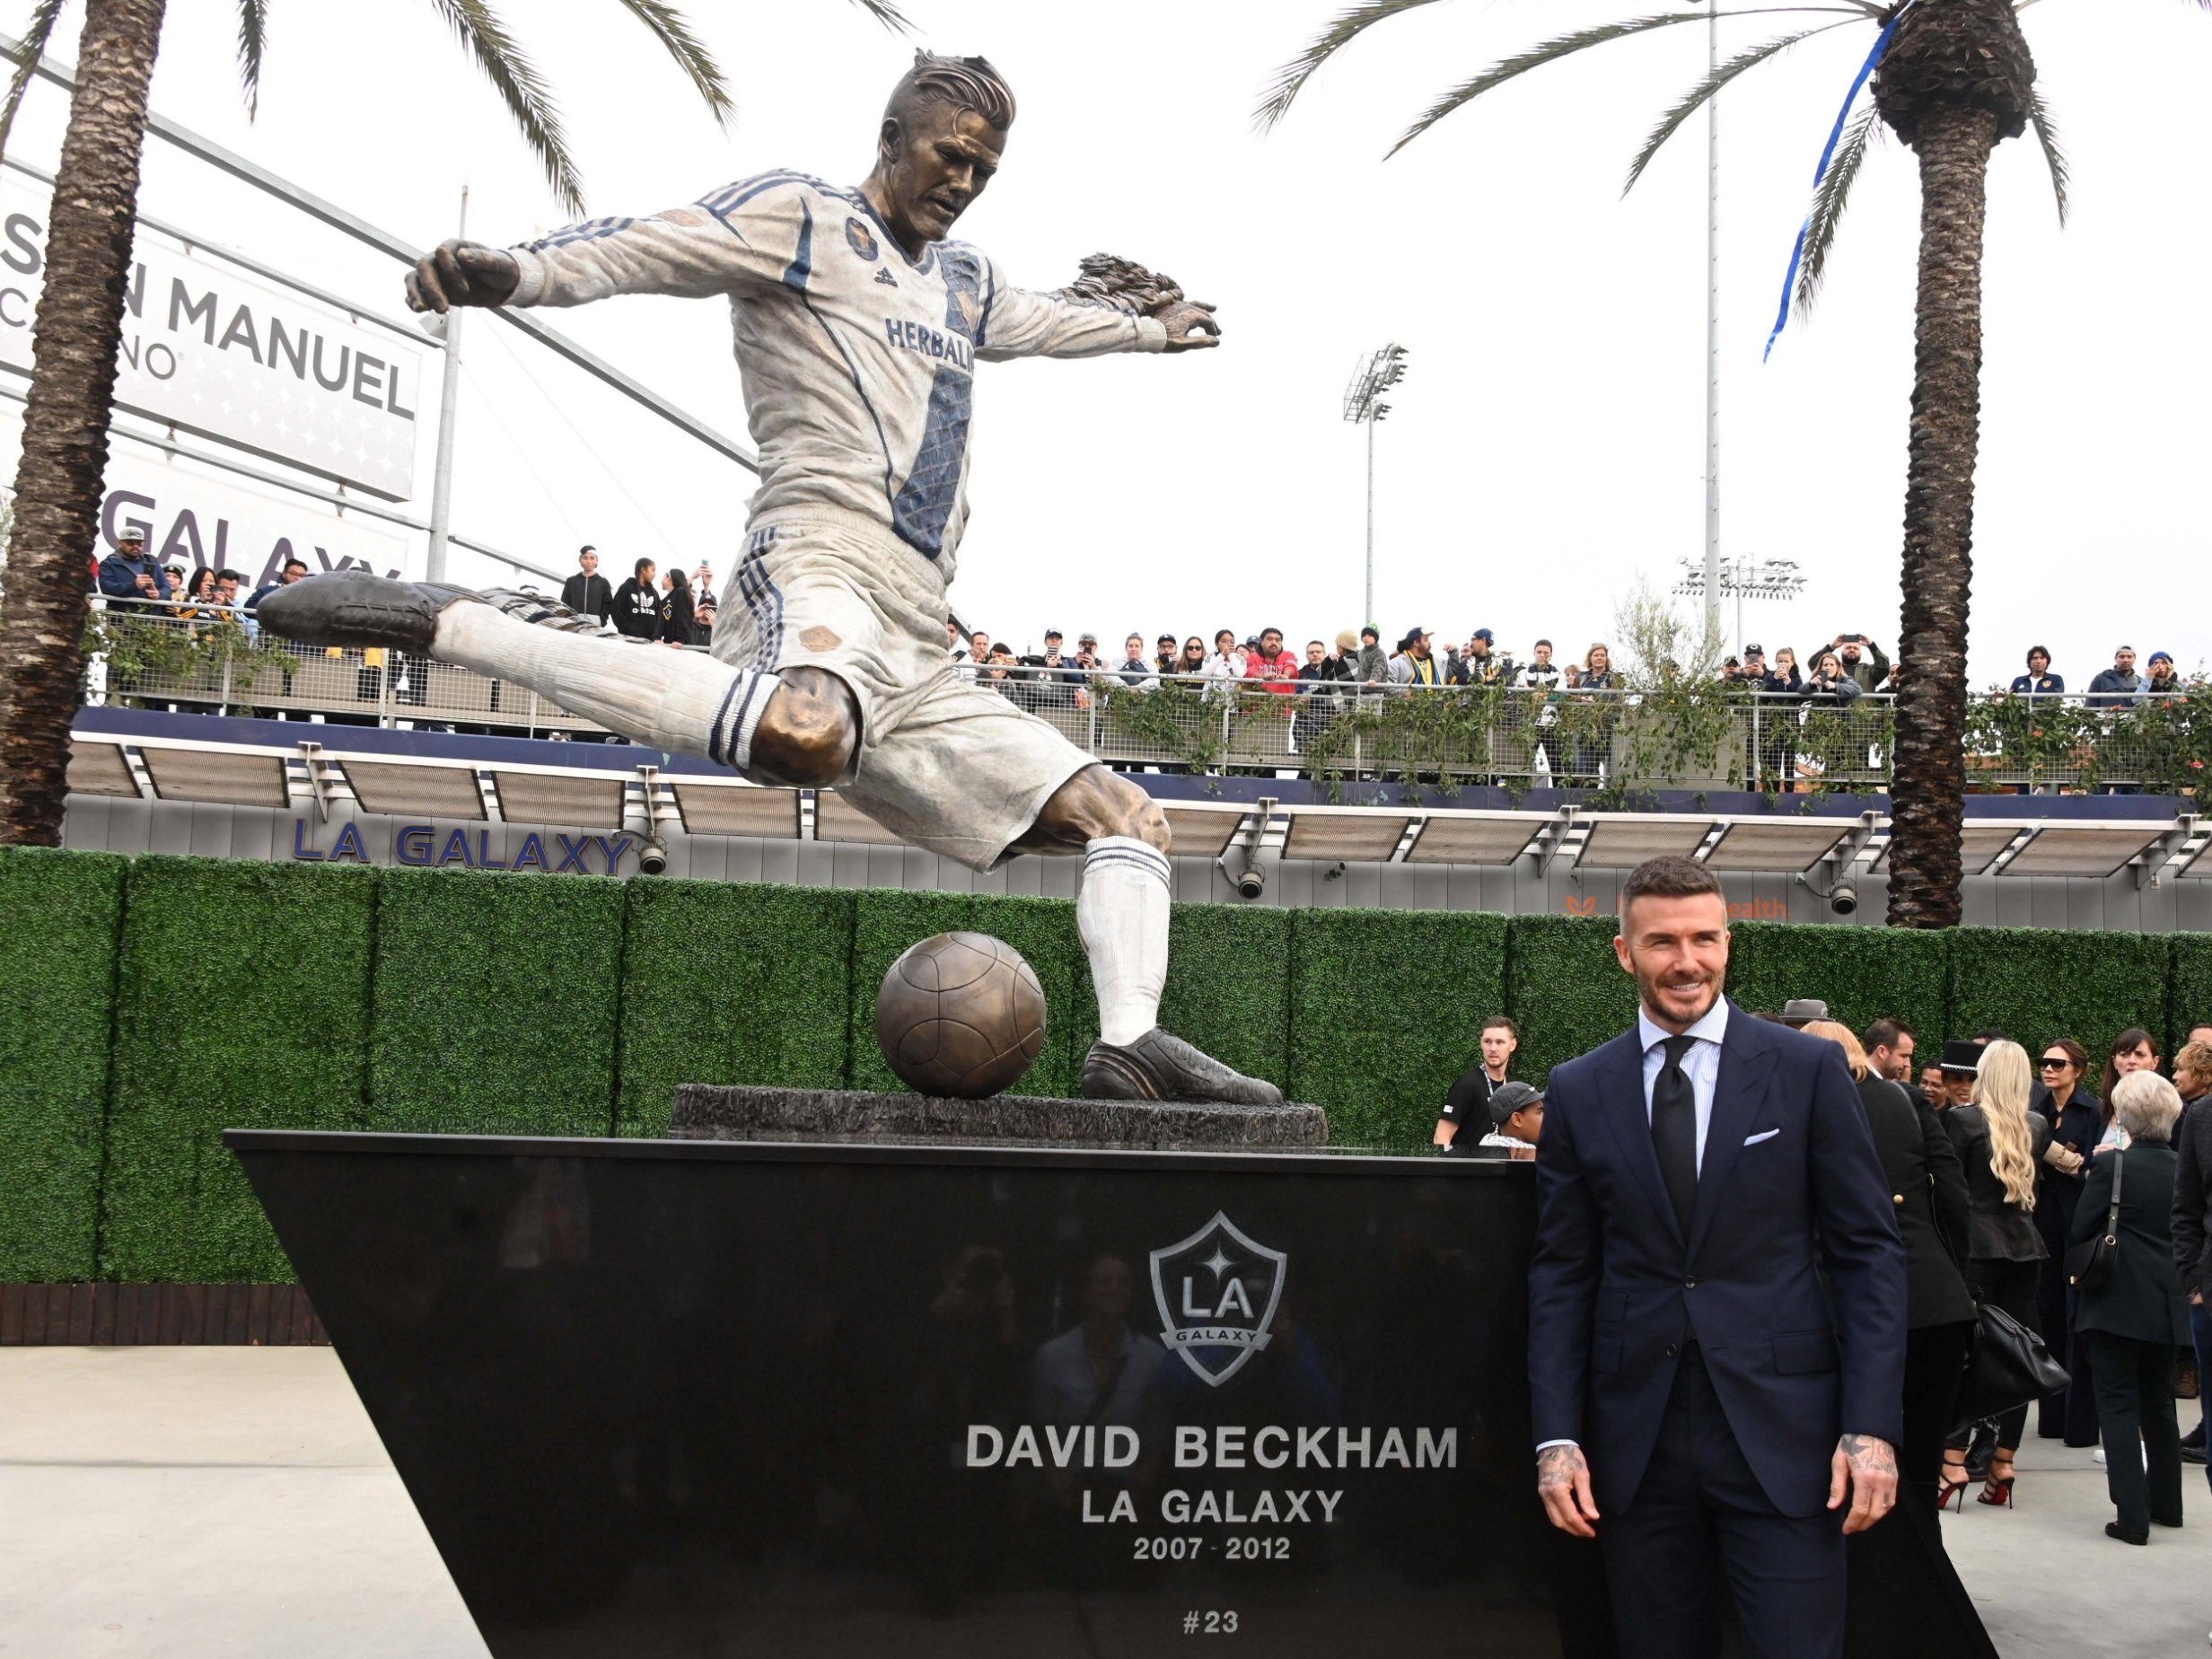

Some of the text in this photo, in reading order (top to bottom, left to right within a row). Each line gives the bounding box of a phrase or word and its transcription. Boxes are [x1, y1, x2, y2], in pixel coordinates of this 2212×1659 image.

[0, 213, 416, 421] SN MANUEL
[0, 287, 176, 380] CNO
[885, 318, 974, 373] HERBALI
[631, 607, 655, 616] aidas
[293, 818, 633, 876] LA GALAXY
[1726, 895, 1792, 920] ealth.
[1181, 1276, 1254, 1319] LA
[1176, 1329, 1258, 1343] GALAXY
[966, 1424, 1458, 1470] DAVID BECKHAM
[1082, 1489, 1345, 1524] LA GALAXY
[1133, 1537, 1202, 1560] 2007
[1225, 1537, 1291, 1560] 2012
[1182, 1610, 1240, 1636] #23
